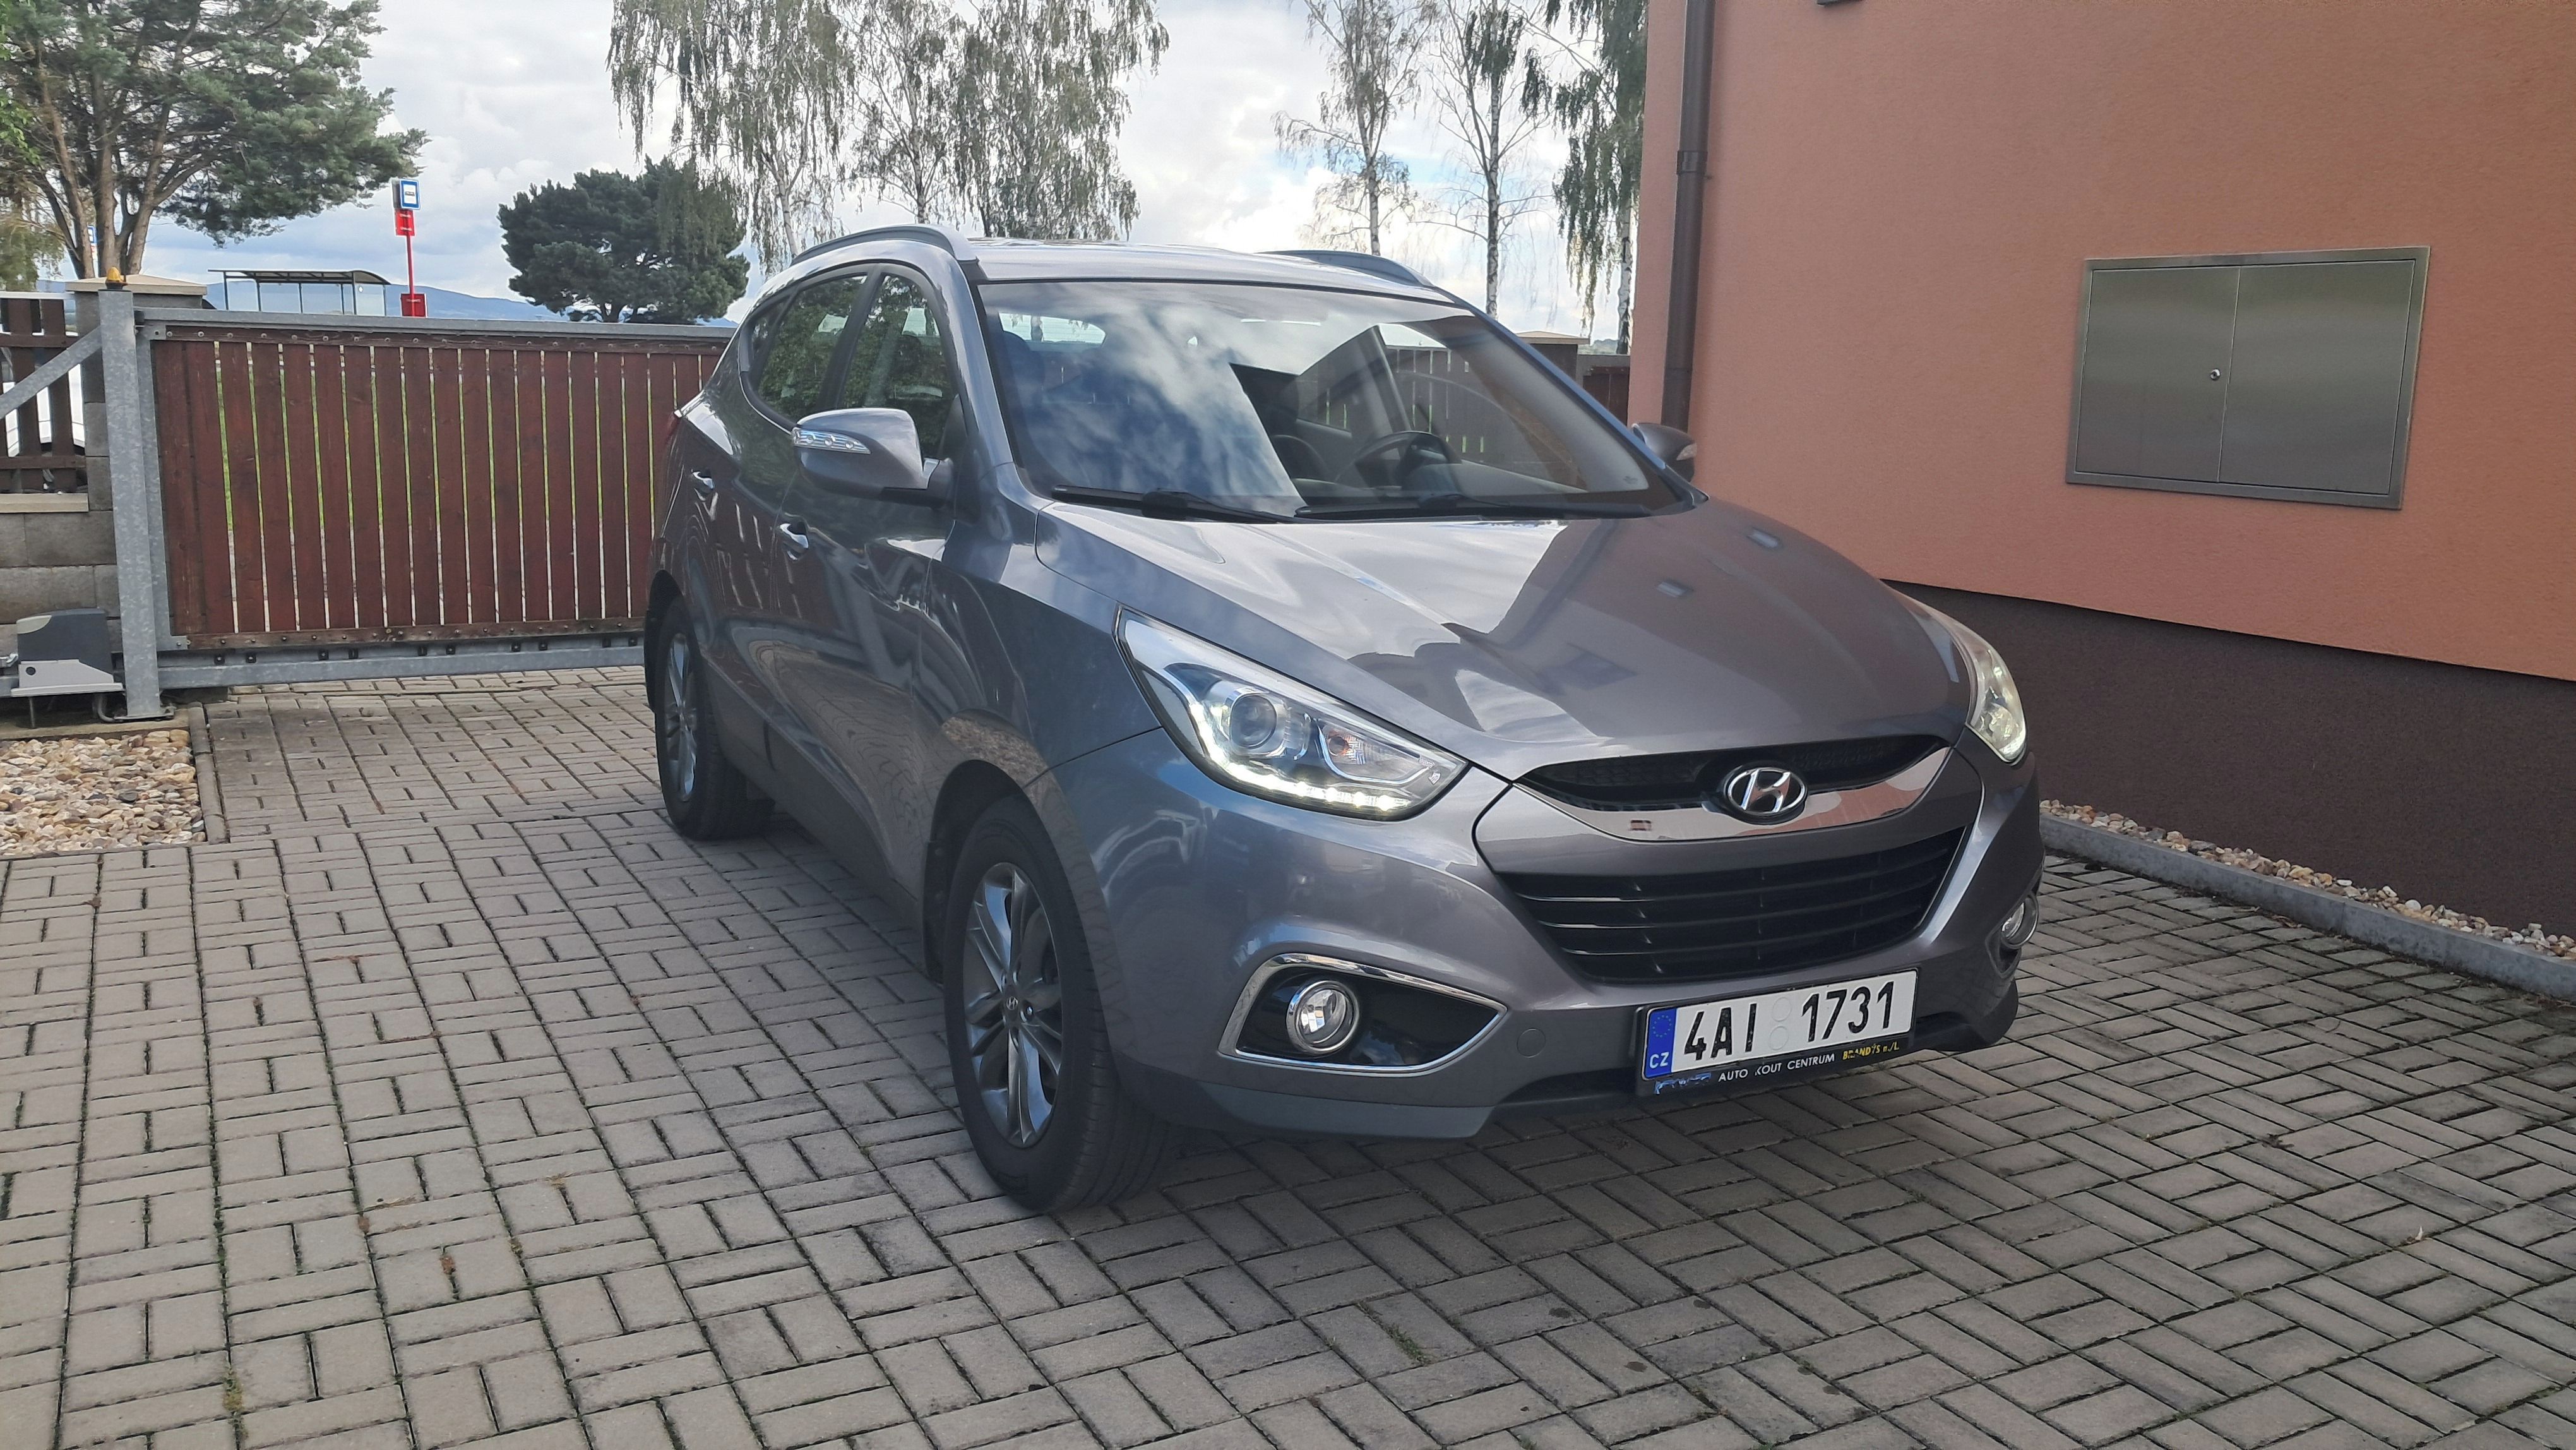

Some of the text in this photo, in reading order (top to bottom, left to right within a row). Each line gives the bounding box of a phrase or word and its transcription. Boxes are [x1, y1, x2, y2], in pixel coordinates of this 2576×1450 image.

[1683, 981, 1895, 1061] 4AI 1731
[1649, 1052, 1669, 1069] CZ
[1718, 1069, 1748, 1082] AUTO
[1787, 1053, 1835, 1070] CENTRUM
